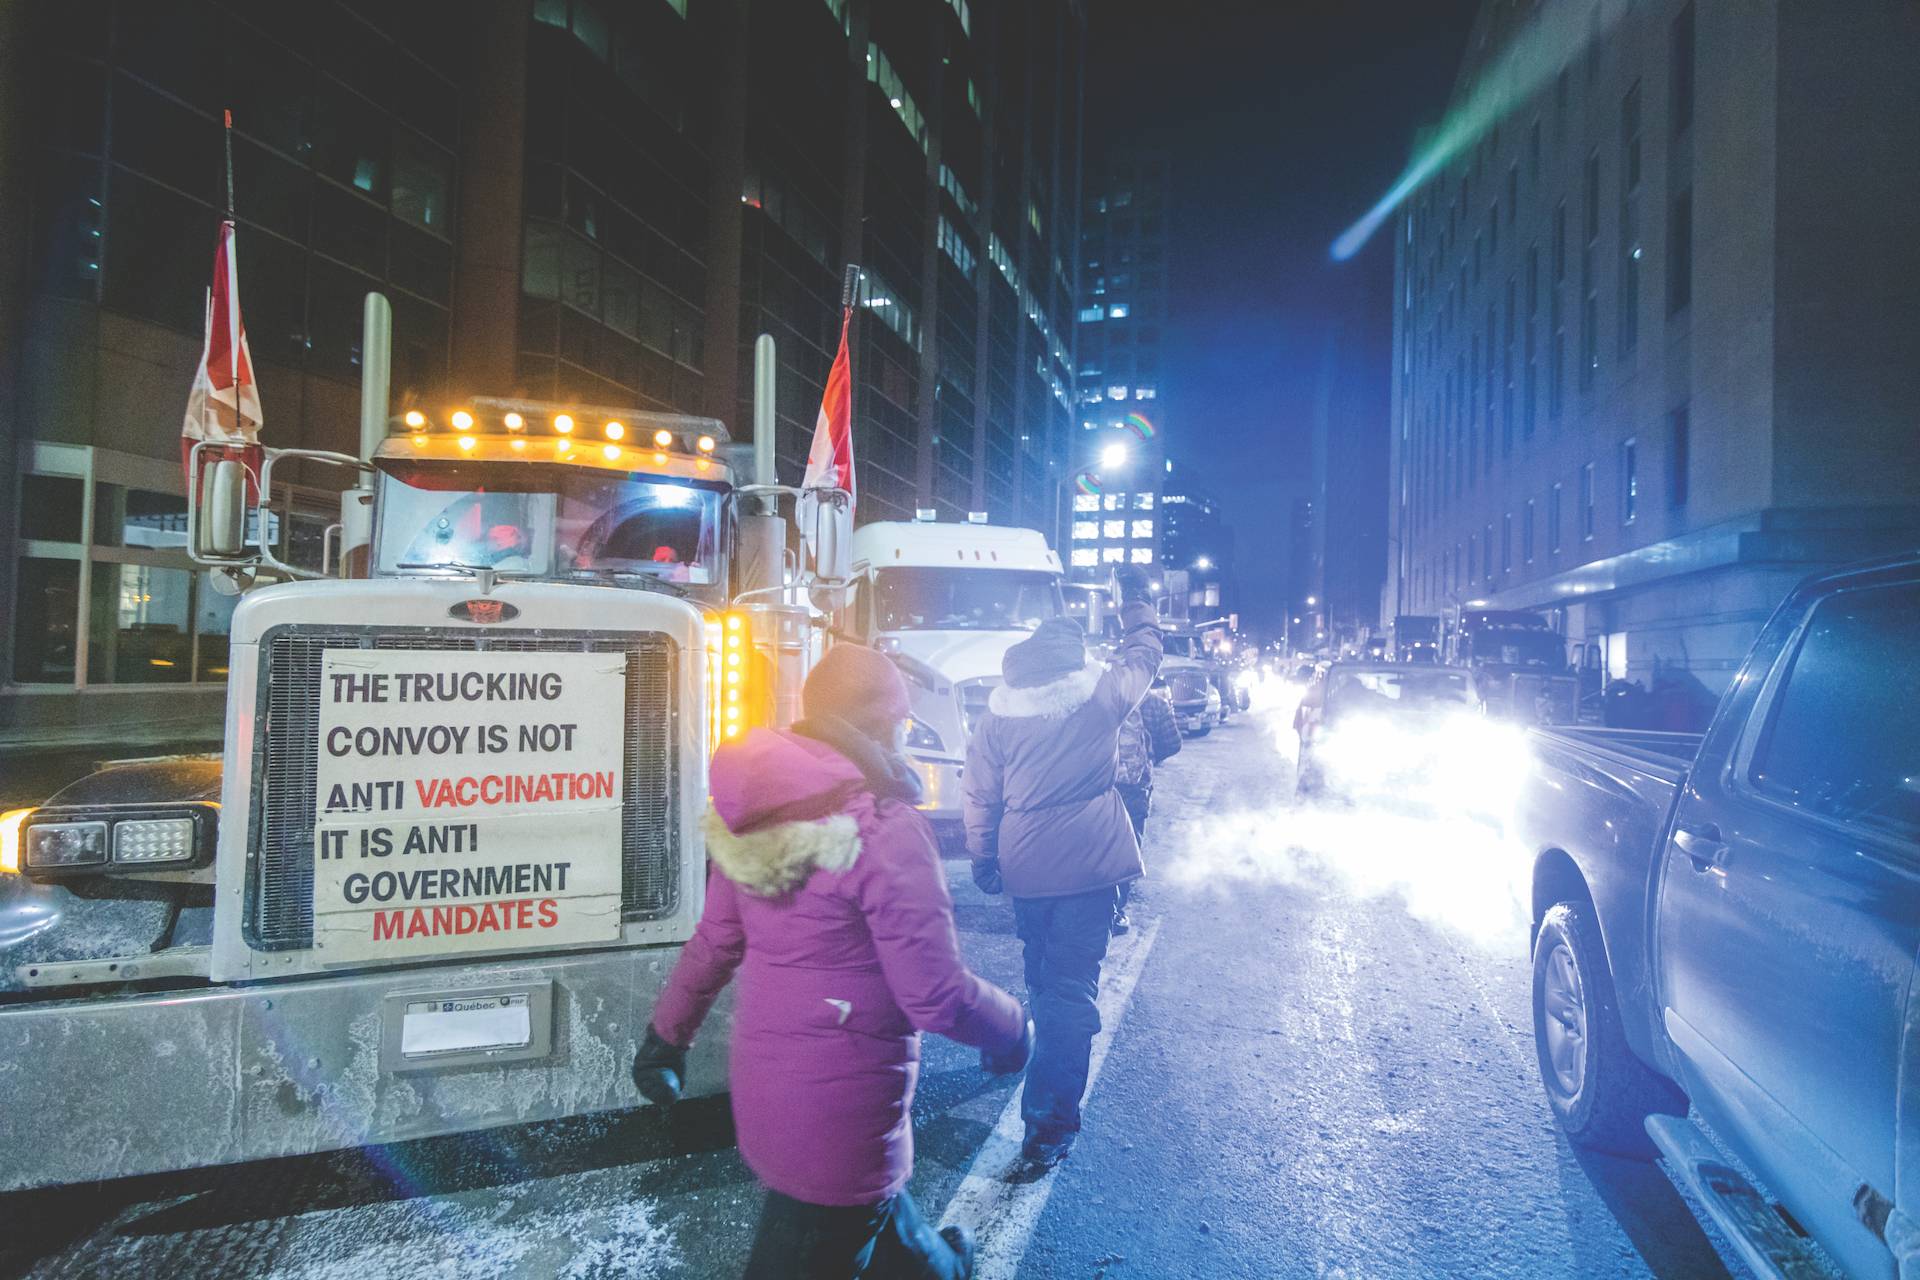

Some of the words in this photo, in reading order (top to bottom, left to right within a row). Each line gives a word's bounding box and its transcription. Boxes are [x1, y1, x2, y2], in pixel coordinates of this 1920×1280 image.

[330, 673, 388, 702] THE
[395, 672, 562, 702] TRUCKING
[326, 725, 470, 757] CONVOY
[478, 724, 508, 754] IS
[519, 724, 577, 752] NOT
[325, 781, 404, 814] ANTI
[416, 771, 614, 808] VACCINATION
[321, 830, 348, 859] IT
[360, 828, 393, 858] IS
[402, 824, 478, 855] ANTI
[343, 862, 571, 904] GOVERNMENT
[373, 899, 558, 941] MANDATES
[454, 1001, 496, 1011] Québec
